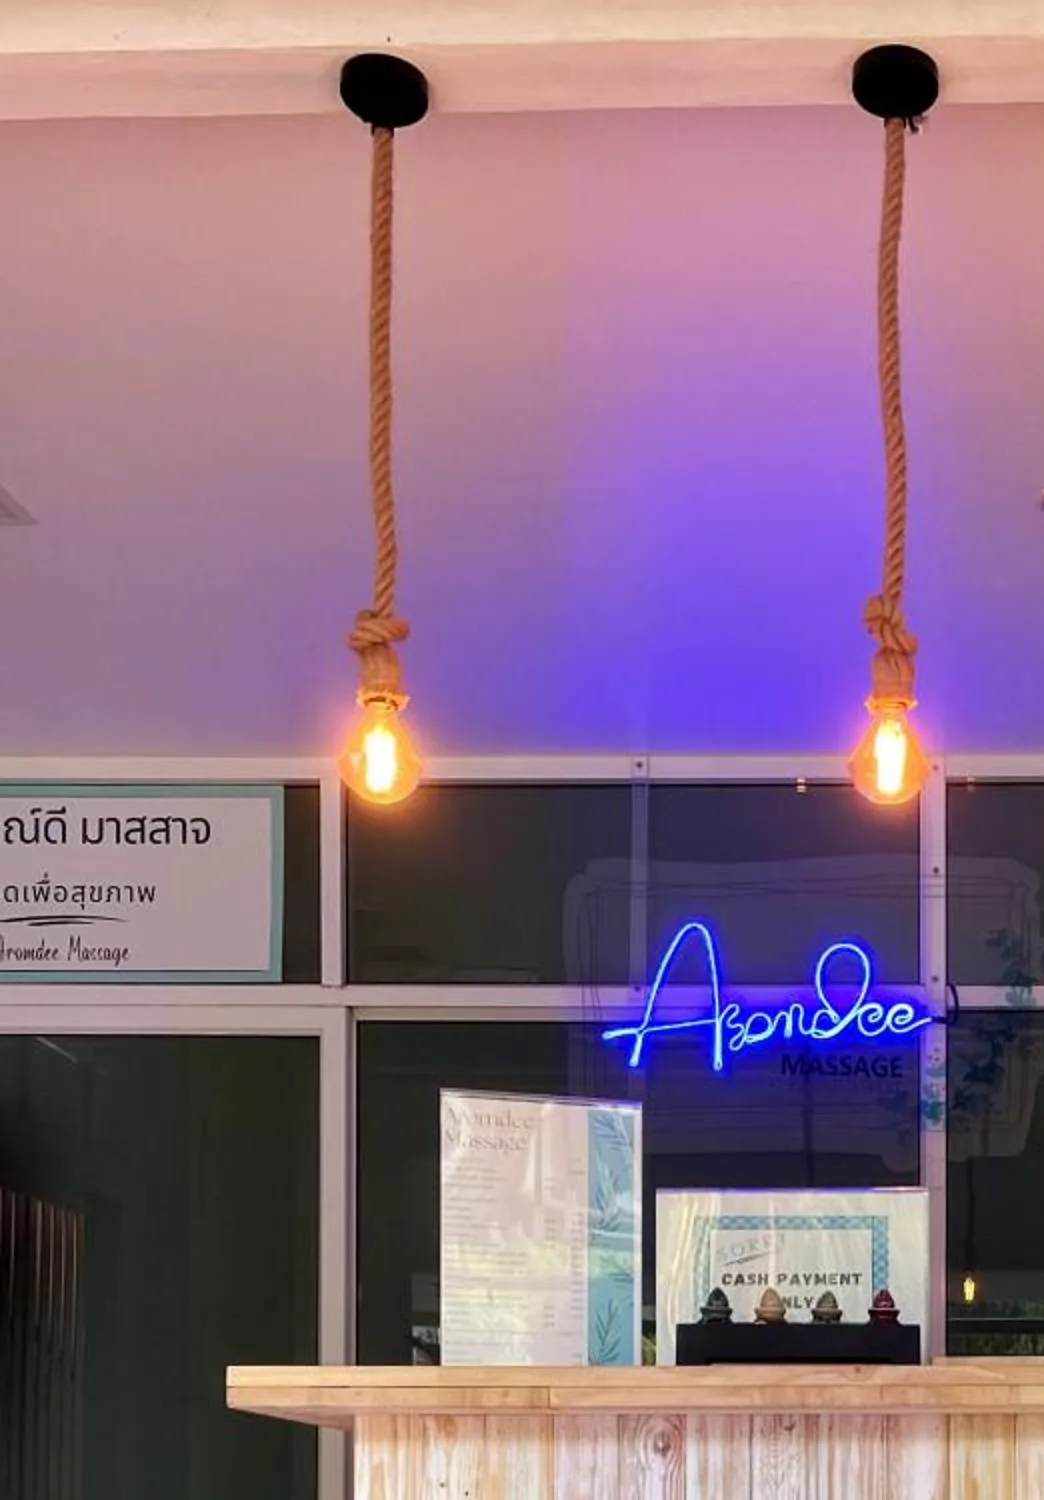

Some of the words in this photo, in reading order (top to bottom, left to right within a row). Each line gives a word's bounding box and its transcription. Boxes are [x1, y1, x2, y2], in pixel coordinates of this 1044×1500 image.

[81, 815, 211, 845] มาสสาจ
[67, 935, 130, 967] Massage
[781, 1054, 904, 1078] MASSAGE
[721, 1273, 769, 1286] CASH
[777, 1273, 863, 1286] PAYMENT
[780, 1296, 815, 1309] NLY
